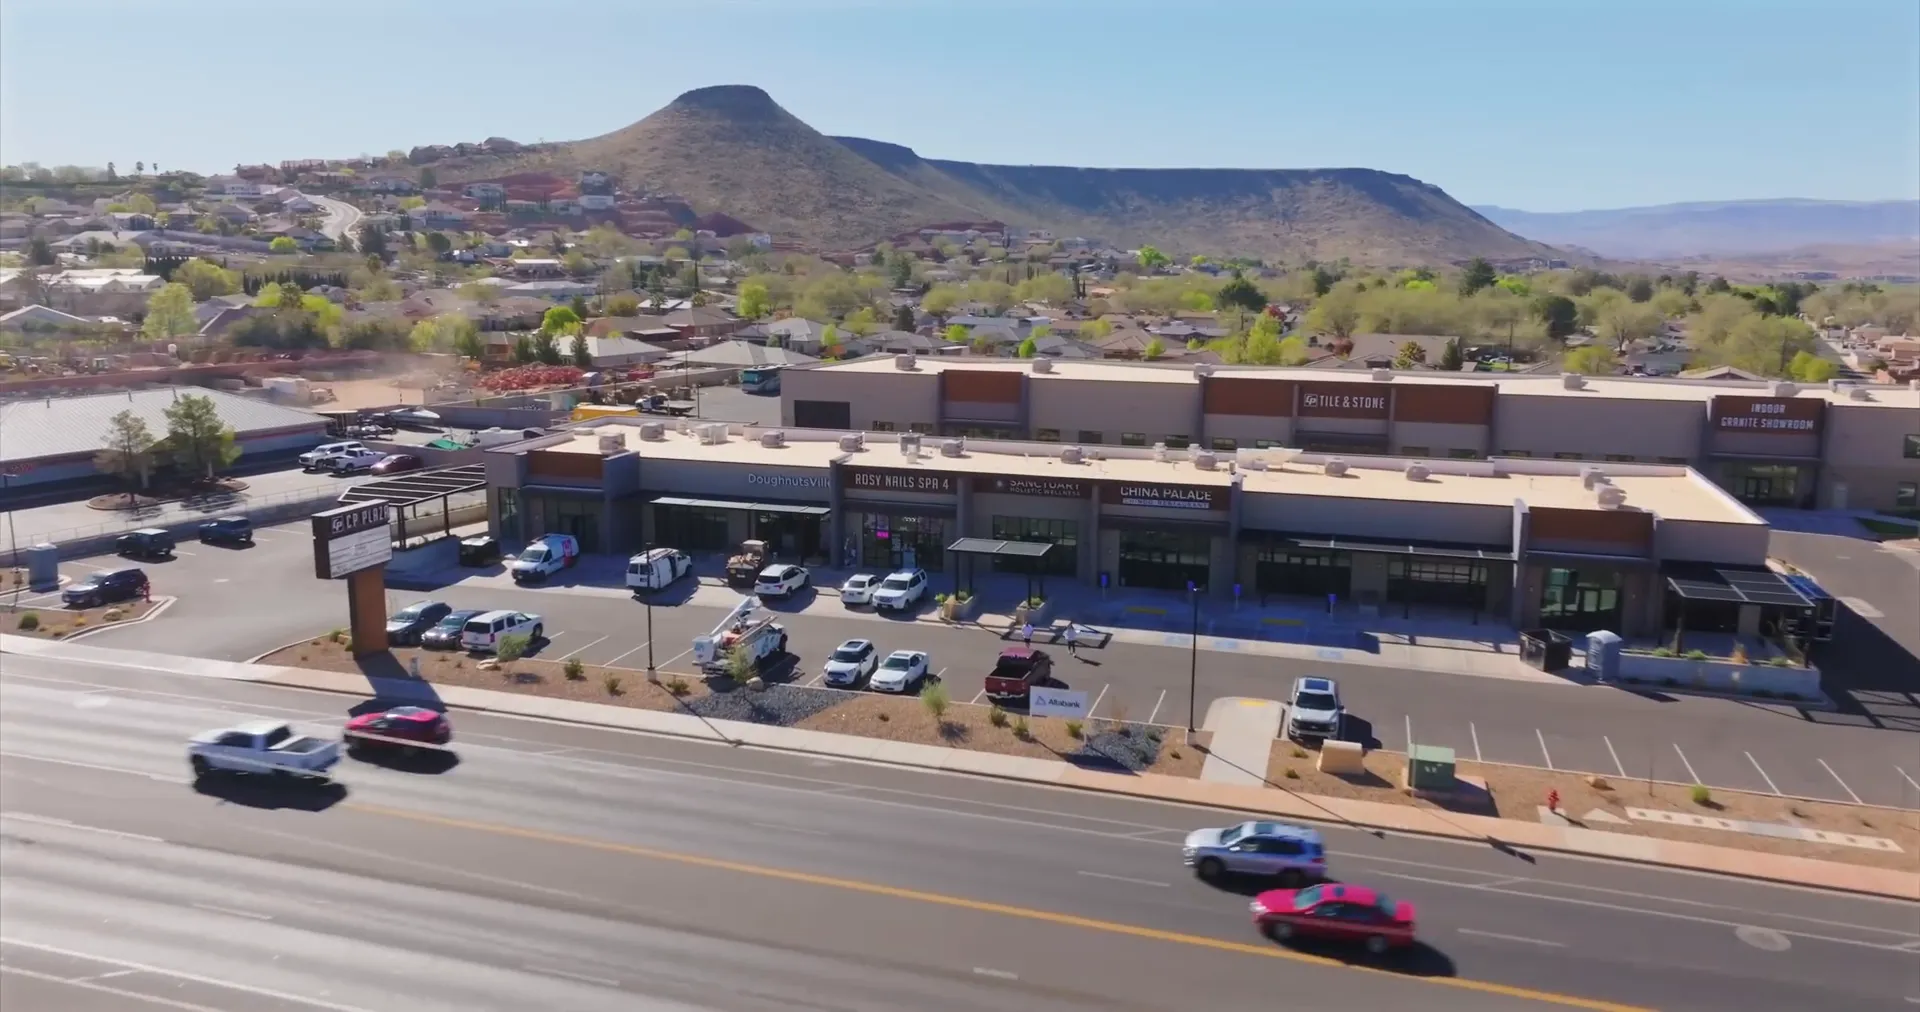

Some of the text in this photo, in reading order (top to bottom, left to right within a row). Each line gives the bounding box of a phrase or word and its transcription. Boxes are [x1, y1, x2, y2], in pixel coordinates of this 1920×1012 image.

[1319, 395, 1340, 407] TILE
[1342, 396, 1350, 408] &
[1352, 396, 1385, 409] STONE
[1751, 403, 1786, 413] INDOOR
[1721, 417, 1814, 430] GRANITE SHOWROOM
[855, 473, 949, 490] ROSY NAILS SPA 4
[1010, 479, 1080, 490] SANCTUARY
[1120, 486, 1212, 501] CHINA PALACE
[346, 513, 359, 529] CP
[361, 504, 390, 525] PLAZA
[1048, 698, 1080, 709] Altabank
